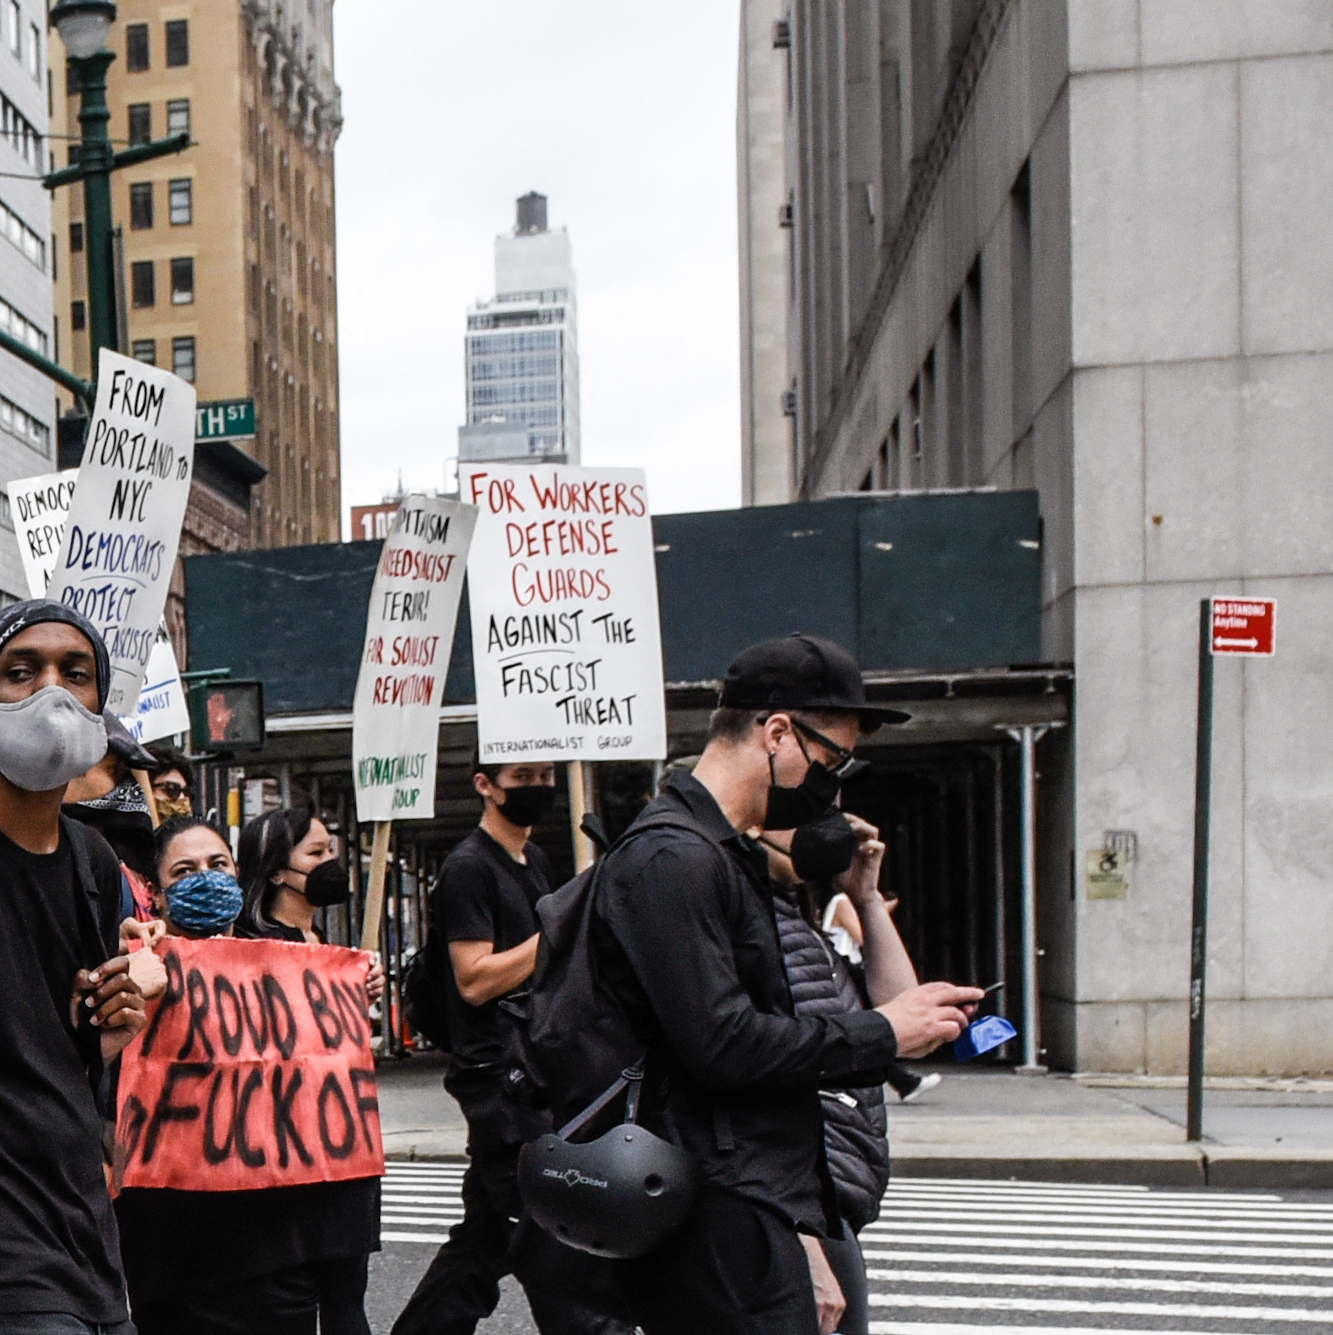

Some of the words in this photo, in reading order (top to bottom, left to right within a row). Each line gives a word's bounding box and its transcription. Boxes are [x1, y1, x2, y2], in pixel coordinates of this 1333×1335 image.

[109, 370, 165, 427] FROM
[196, 406, 226, 436] TH
[227, 404, 248, 421] ST
[89, 418, 174, 480] PORTLAND
[176, 455, 189, 481] TO
[17, 481, 76, 522] DEMOCR
[109, 478, 153, 523] NYC
[470, 472, 525, 514] FOR
[530, 472, 646, 517] WORKERS
[65, 525, 165, 581] DEMOCRATS
[506, 519, 618, 557] DEFENSE
[60, 583, 137, 622] PROTECT
[512, 562, 610, 607] GUARDS
[1215, 602, 1227, 615] NO
[488, 609, 584, 653] AGAINST
[591, 612, 636, 645] THE
[501, 658, 603, 698] FASCIST
[556, 694, 637, 726] THREAT
[484, 736, 585, 756] INTERNATIONALIST
[597, 736, 633, 750] GROUP
[141, 950, 297, 1060] PROUD
[142, 1060, 314, 1168] FUCK
